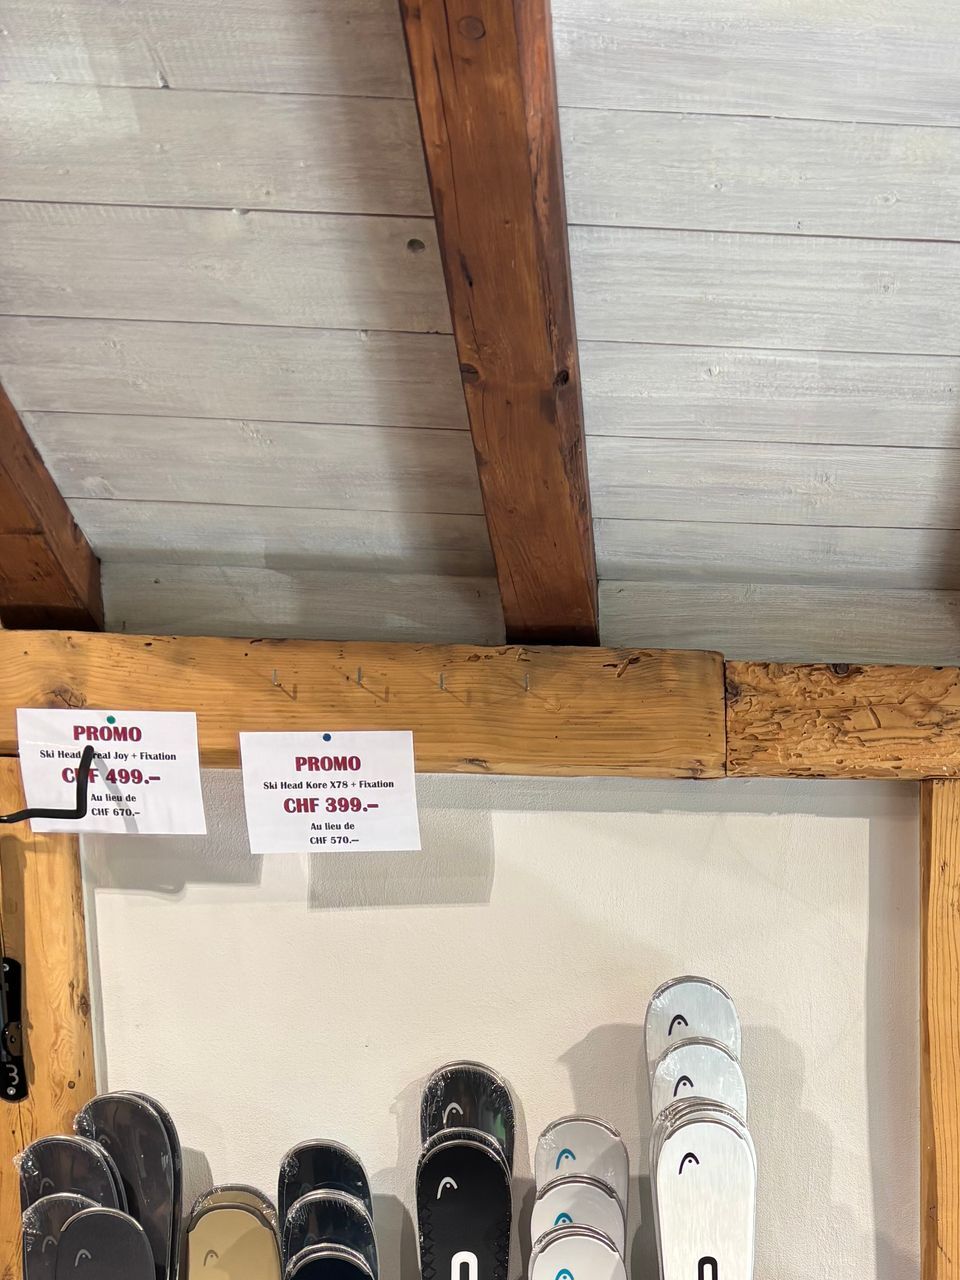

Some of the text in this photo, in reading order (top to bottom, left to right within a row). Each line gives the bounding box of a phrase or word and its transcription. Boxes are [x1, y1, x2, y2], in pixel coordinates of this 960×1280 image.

[73, 725, 142, 742] PROMO
[40, 750, 55, 759] Ski
[58, 751, 81, 760] Head
[113, 751, 129, 761] Joy
[140, 752, 177, 761] Fixation
[295, 755, 361, 772] PROMO
[106, 768, 161, 785] 499.-
[263, 781, 278, 790] Ski
[280, 781, 303, 790] Head
[306, 781, 328, 789] Kore
[329, 780, 348, 789] X78
[358, 780, 394, 789] Fixation
[90, 794, 137, 802] Au lieu de
[283, 797, 379, 813] CHF 399.-
[91, 808, 110, 816] CHF
[310, 822, 355, 831] Au lieu de
[310, 836, 328, 845] CHF
